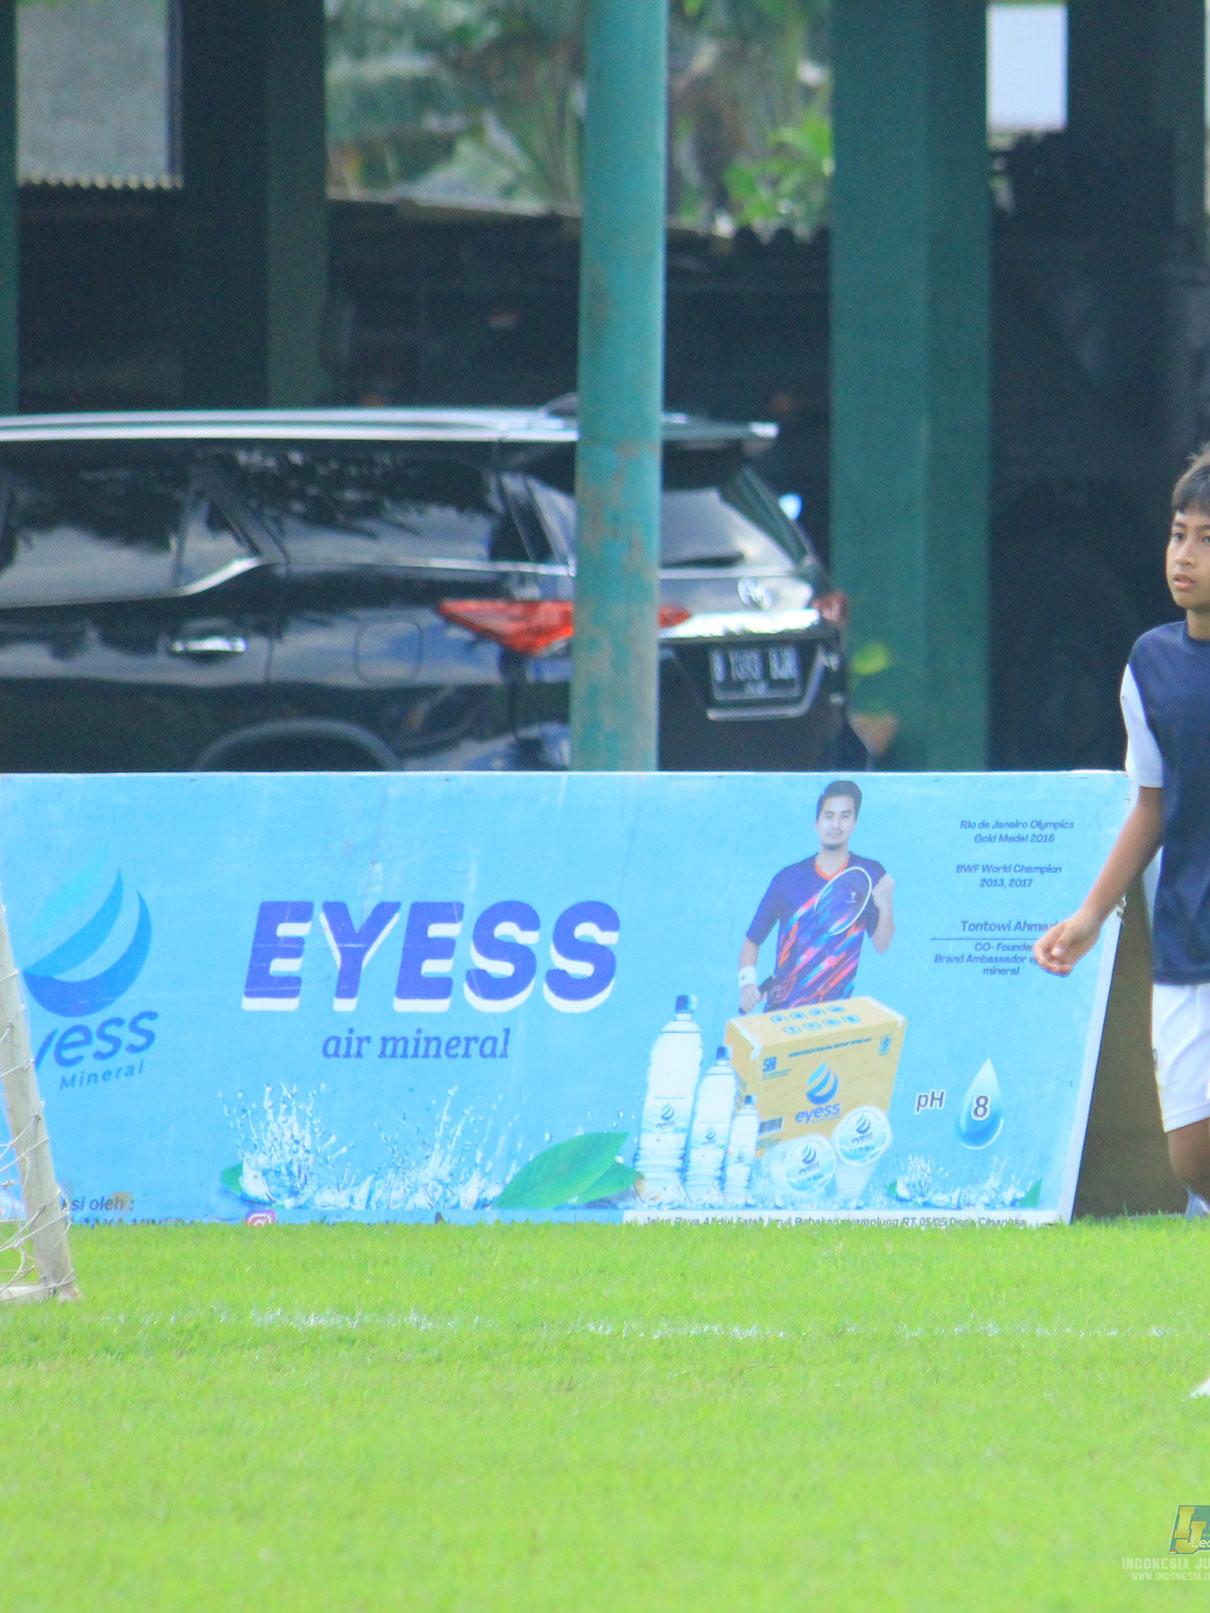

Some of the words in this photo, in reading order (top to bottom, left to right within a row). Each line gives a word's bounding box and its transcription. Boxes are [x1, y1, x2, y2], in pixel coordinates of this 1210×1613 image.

[978, 820, 990, 829] de
[1030, 819, 1074, 831] Olympics
[974, 834, 996, 843] Gold
[998, 834, 1029, 843] Medal
[956, 864, 980, 873] BWF
[982, 864, 1012, 873] World
[1013, 864, 1062, 875] Champion
[1008, 878, 1033, 888] 2017
[961, 920, 1011, 932] Tontowi
[1013, 920, 1058, 932] Ahma
[996, 942, 1033, 951] Founde
[242, 900, 620, 1012] EYESS
[934, 955, 964, 963] Brand
[966, 955, 1027, 964] Ambassador
[983, 966, 1020, 975] mineral
[322, 1027, 371, 1059] air
[377, 1027, 511, 1059] mineral
[60, 1058, 145, 1090] Mineral
[915, 1090, 945, 1113] pH
[972, 1094, 990, 1119] 8
[795, 1103, 841, 1124] eyess
[89, 1196, 124, 1211] oleh
